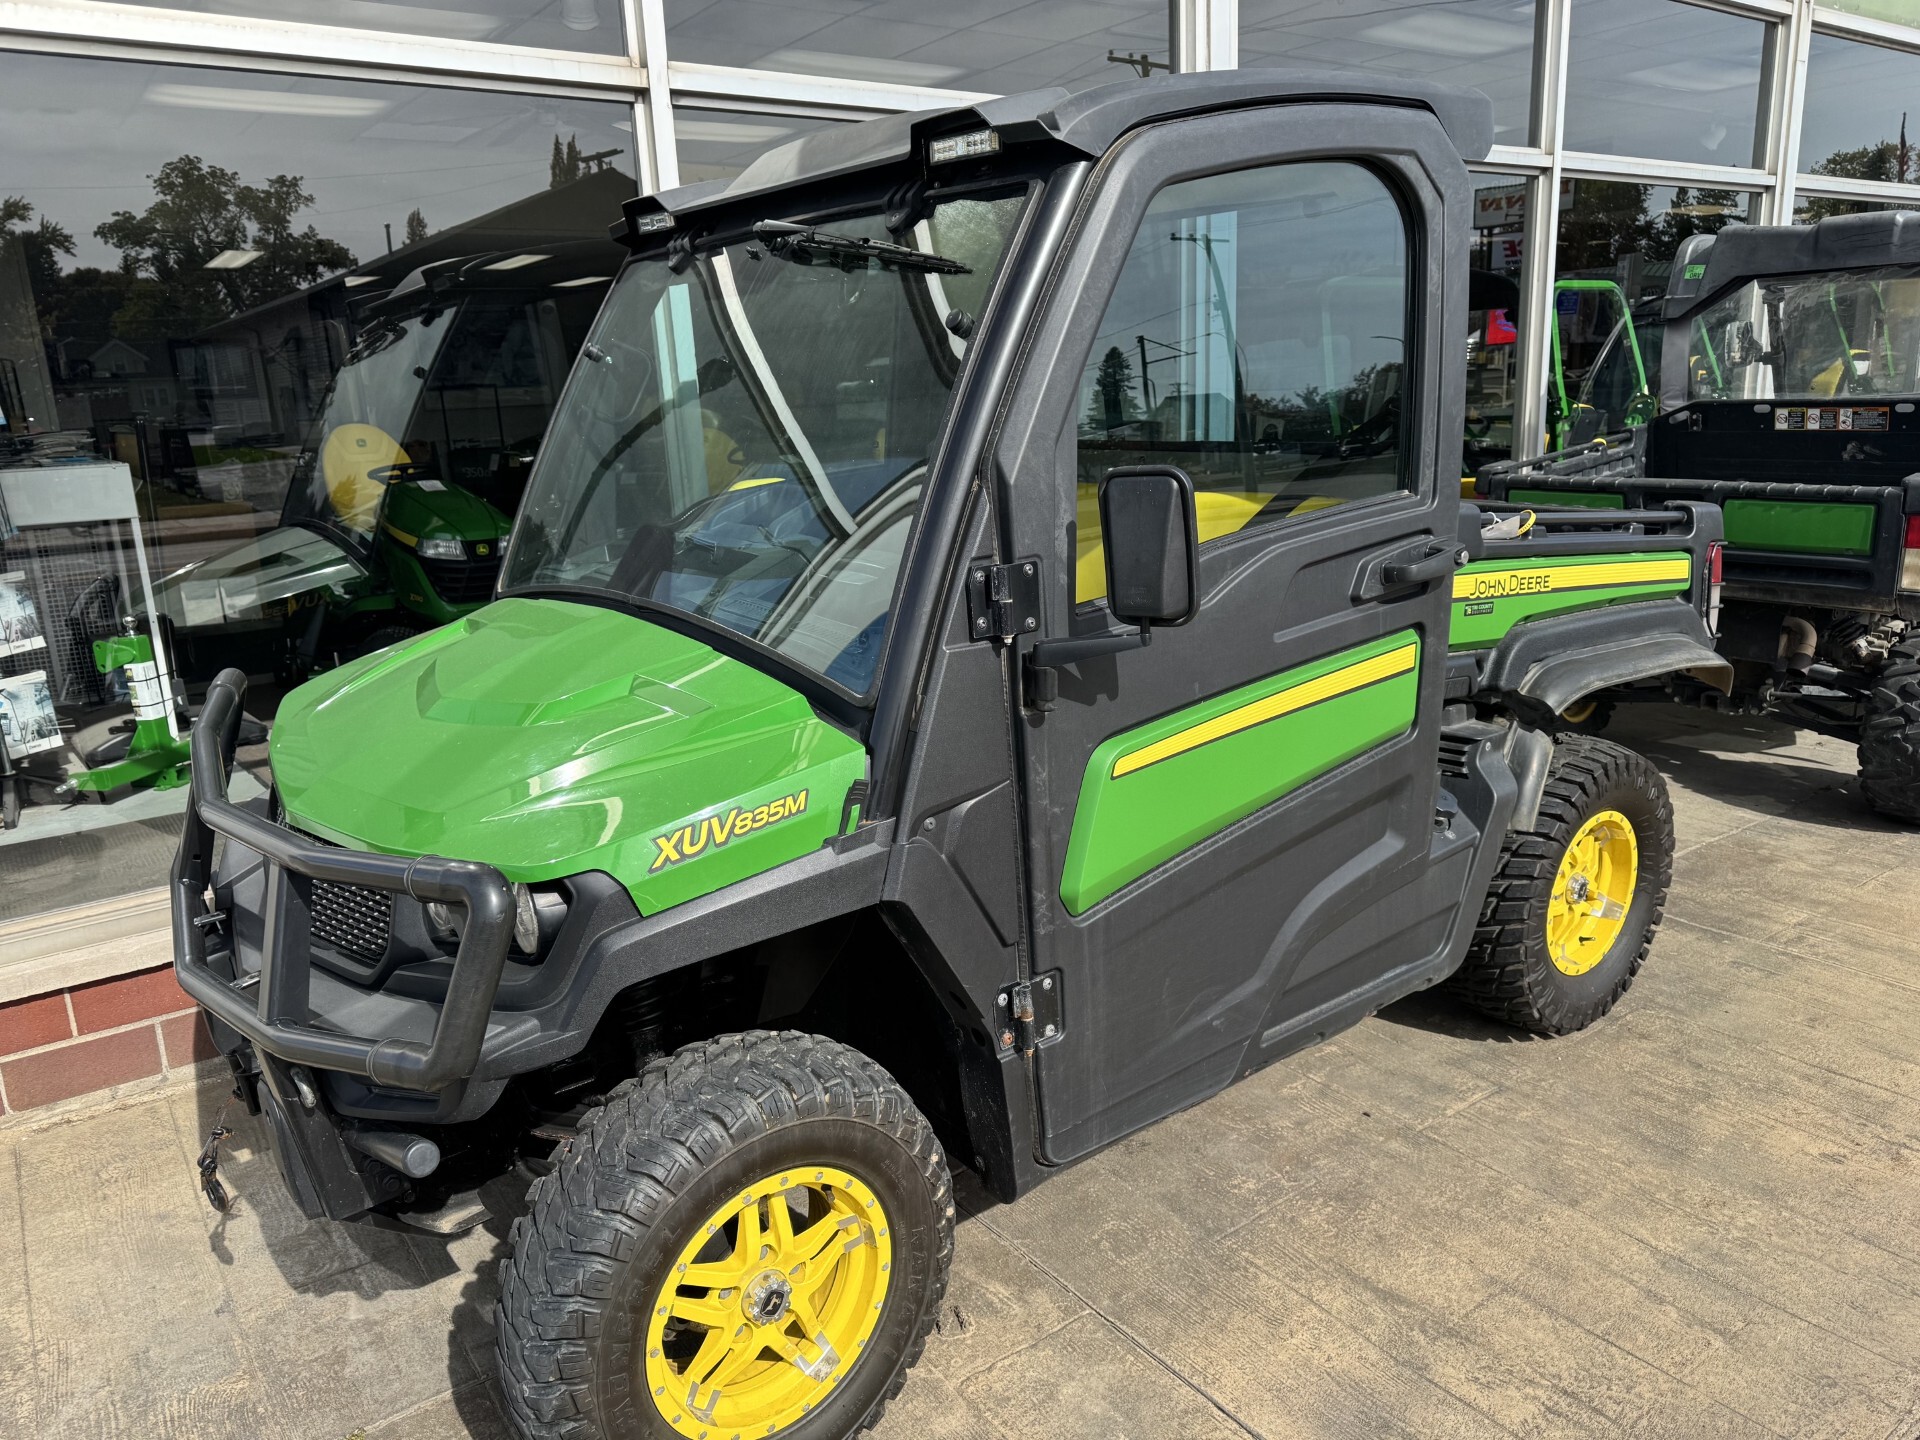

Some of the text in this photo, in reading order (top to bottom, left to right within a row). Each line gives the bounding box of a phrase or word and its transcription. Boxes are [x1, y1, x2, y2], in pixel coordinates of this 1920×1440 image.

[1469, 574, 1551, 596] JOHN DEERE
[647, 788, 809, 874] XUV835M
